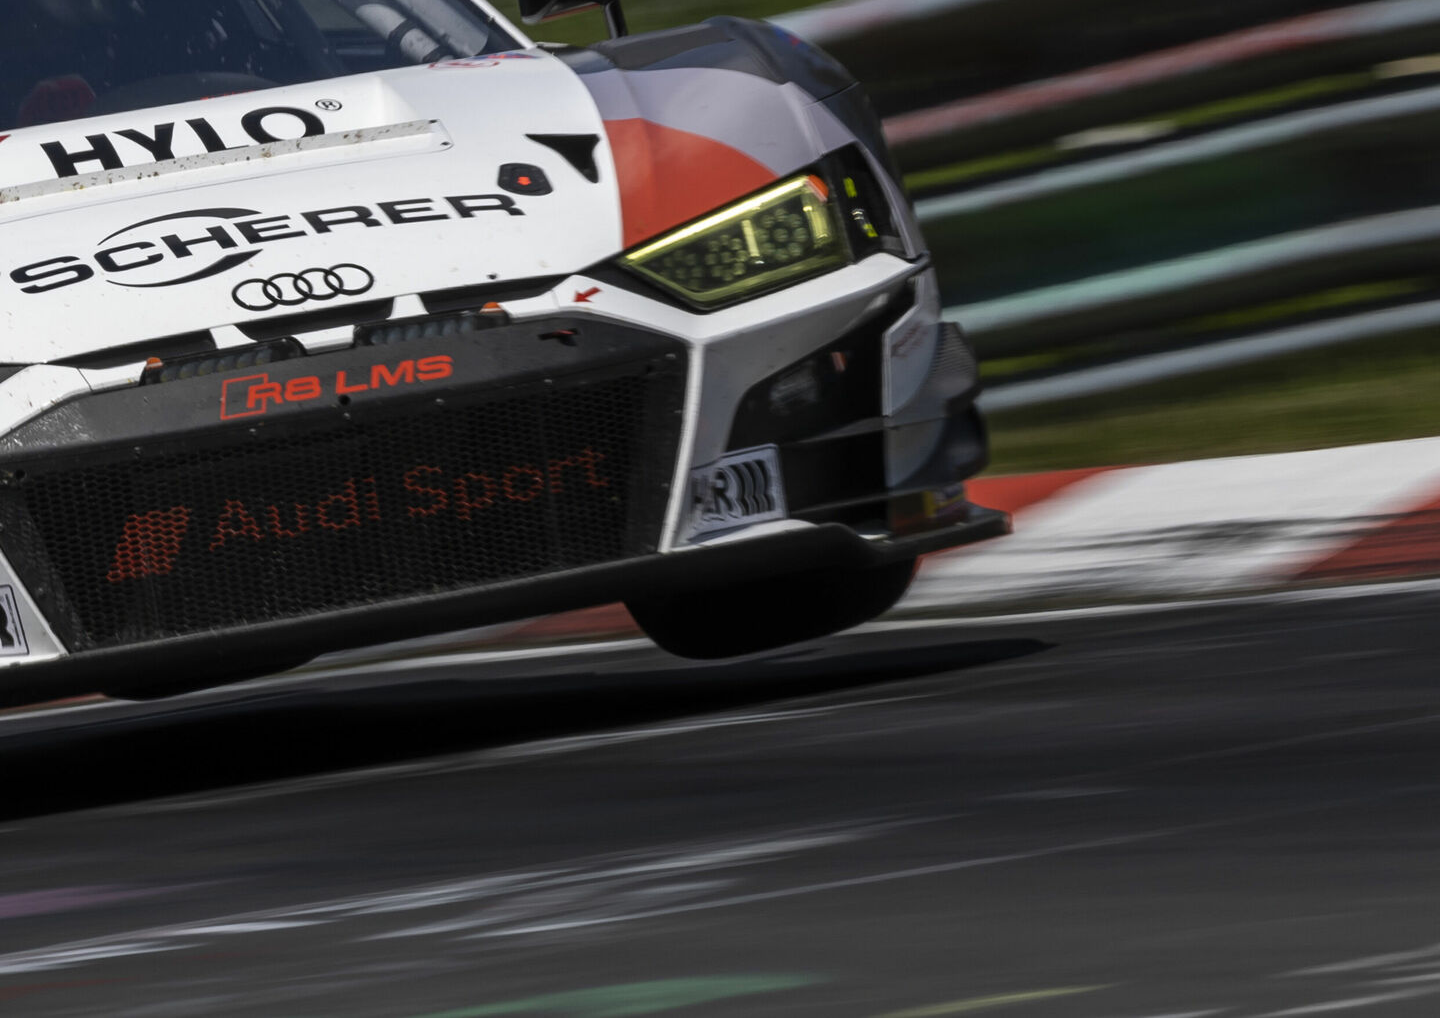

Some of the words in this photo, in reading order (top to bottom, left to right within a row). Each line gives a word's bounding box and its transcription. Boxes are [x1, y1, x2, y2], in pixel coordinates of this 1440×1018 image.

[9, 193, 526, 294] SCHERER
[243, 374, 322, 410] R8
[335, 355, 454, 394] LMS
[209, 475, 381, 551] Audi
[403, 447, 609, 520] Sport
